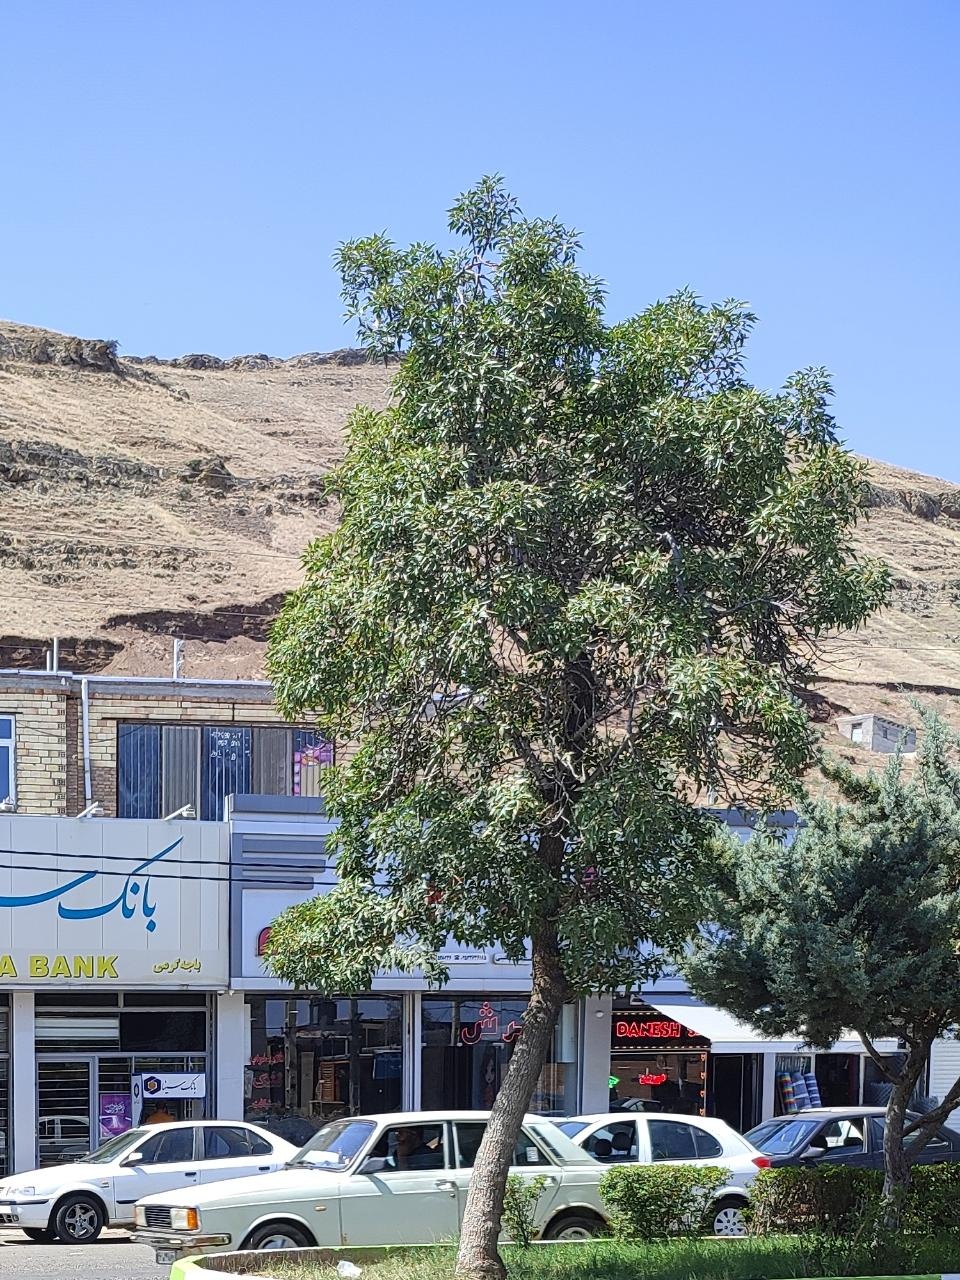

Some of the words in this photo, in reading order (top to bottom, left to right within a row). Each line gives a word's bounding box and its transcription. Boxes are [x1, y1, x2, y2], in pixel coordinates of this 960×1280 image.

[57, 835, 184, 933] بانک
[28, 955, 119, 979] BANK
[616, 1021, 681, 1038] DANESH
[161, 1080, 187, 1095] سینا
[180, 1074, 201, 1094] بانک
